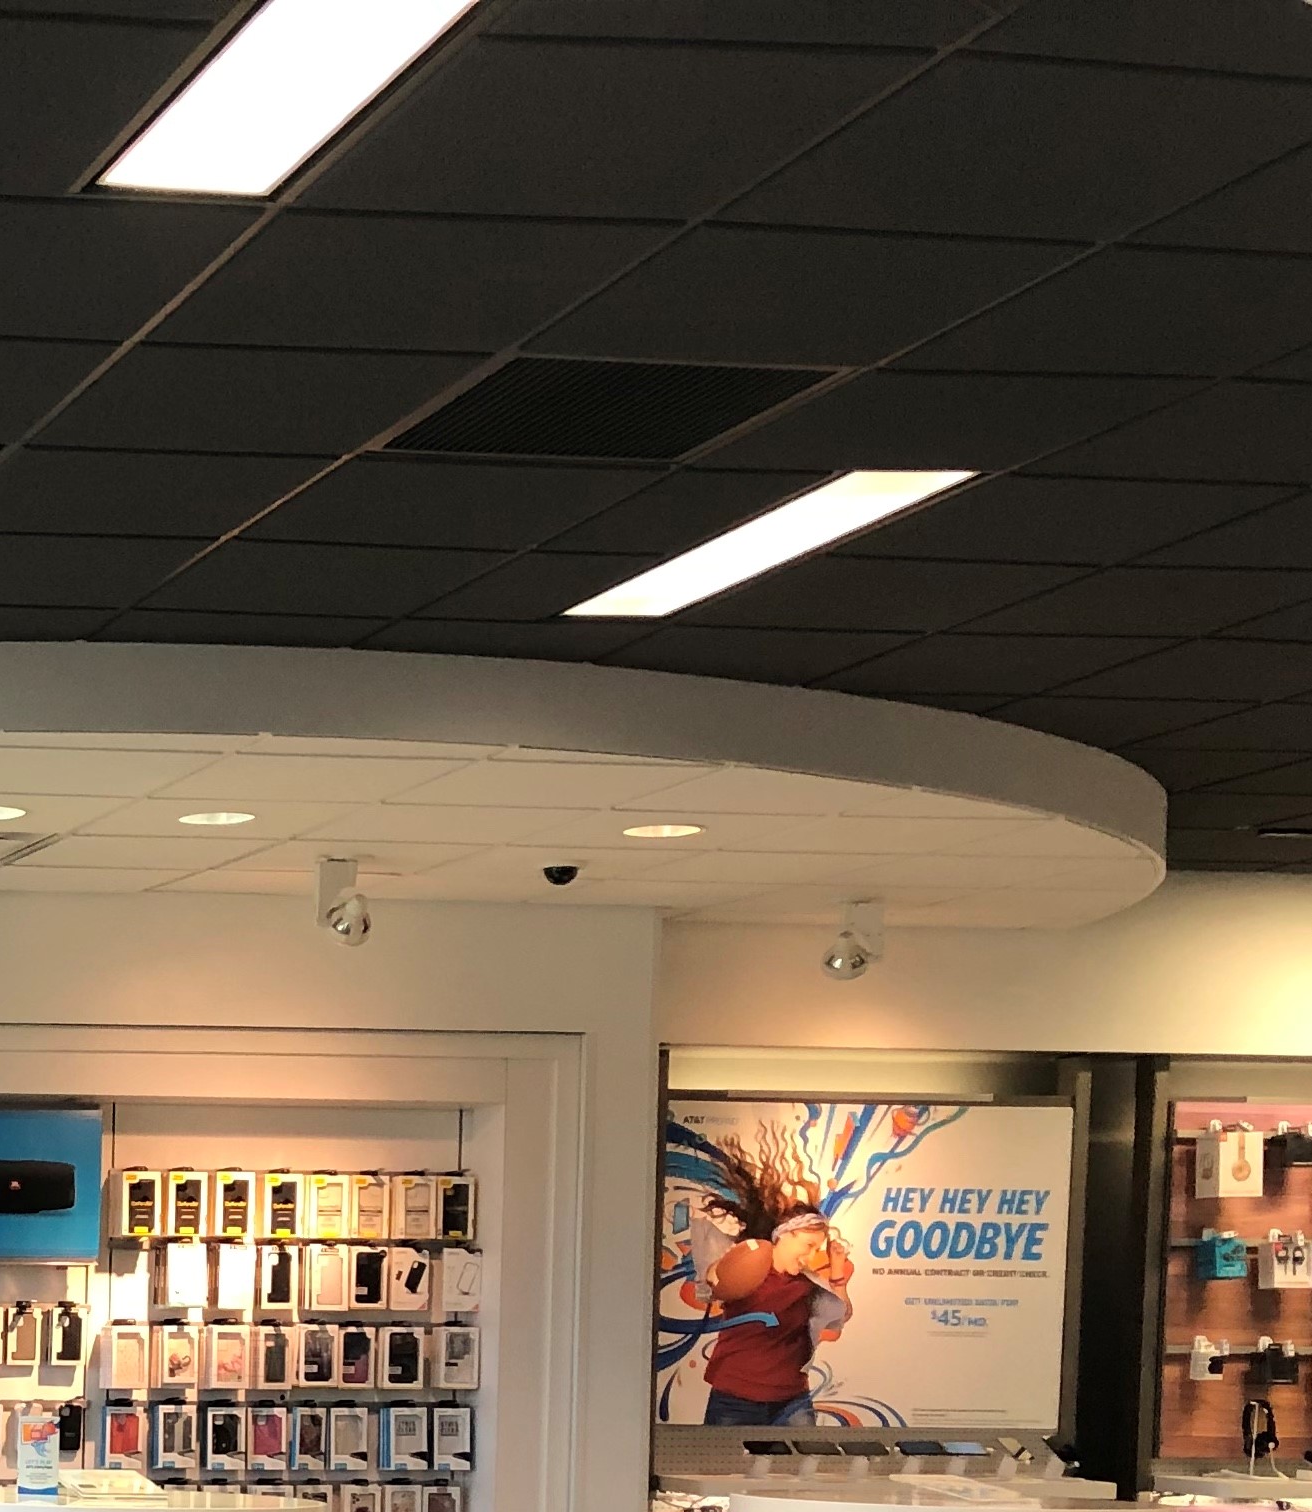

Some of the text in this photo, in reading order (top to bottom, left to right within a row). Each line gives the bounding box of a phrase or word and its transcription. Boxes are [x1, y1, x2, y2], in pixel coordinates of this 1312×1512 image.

[881, 1187, 1051, 1215] HEY HEY HEY
[870, 1219, 1050, 1261] GOODBYE
